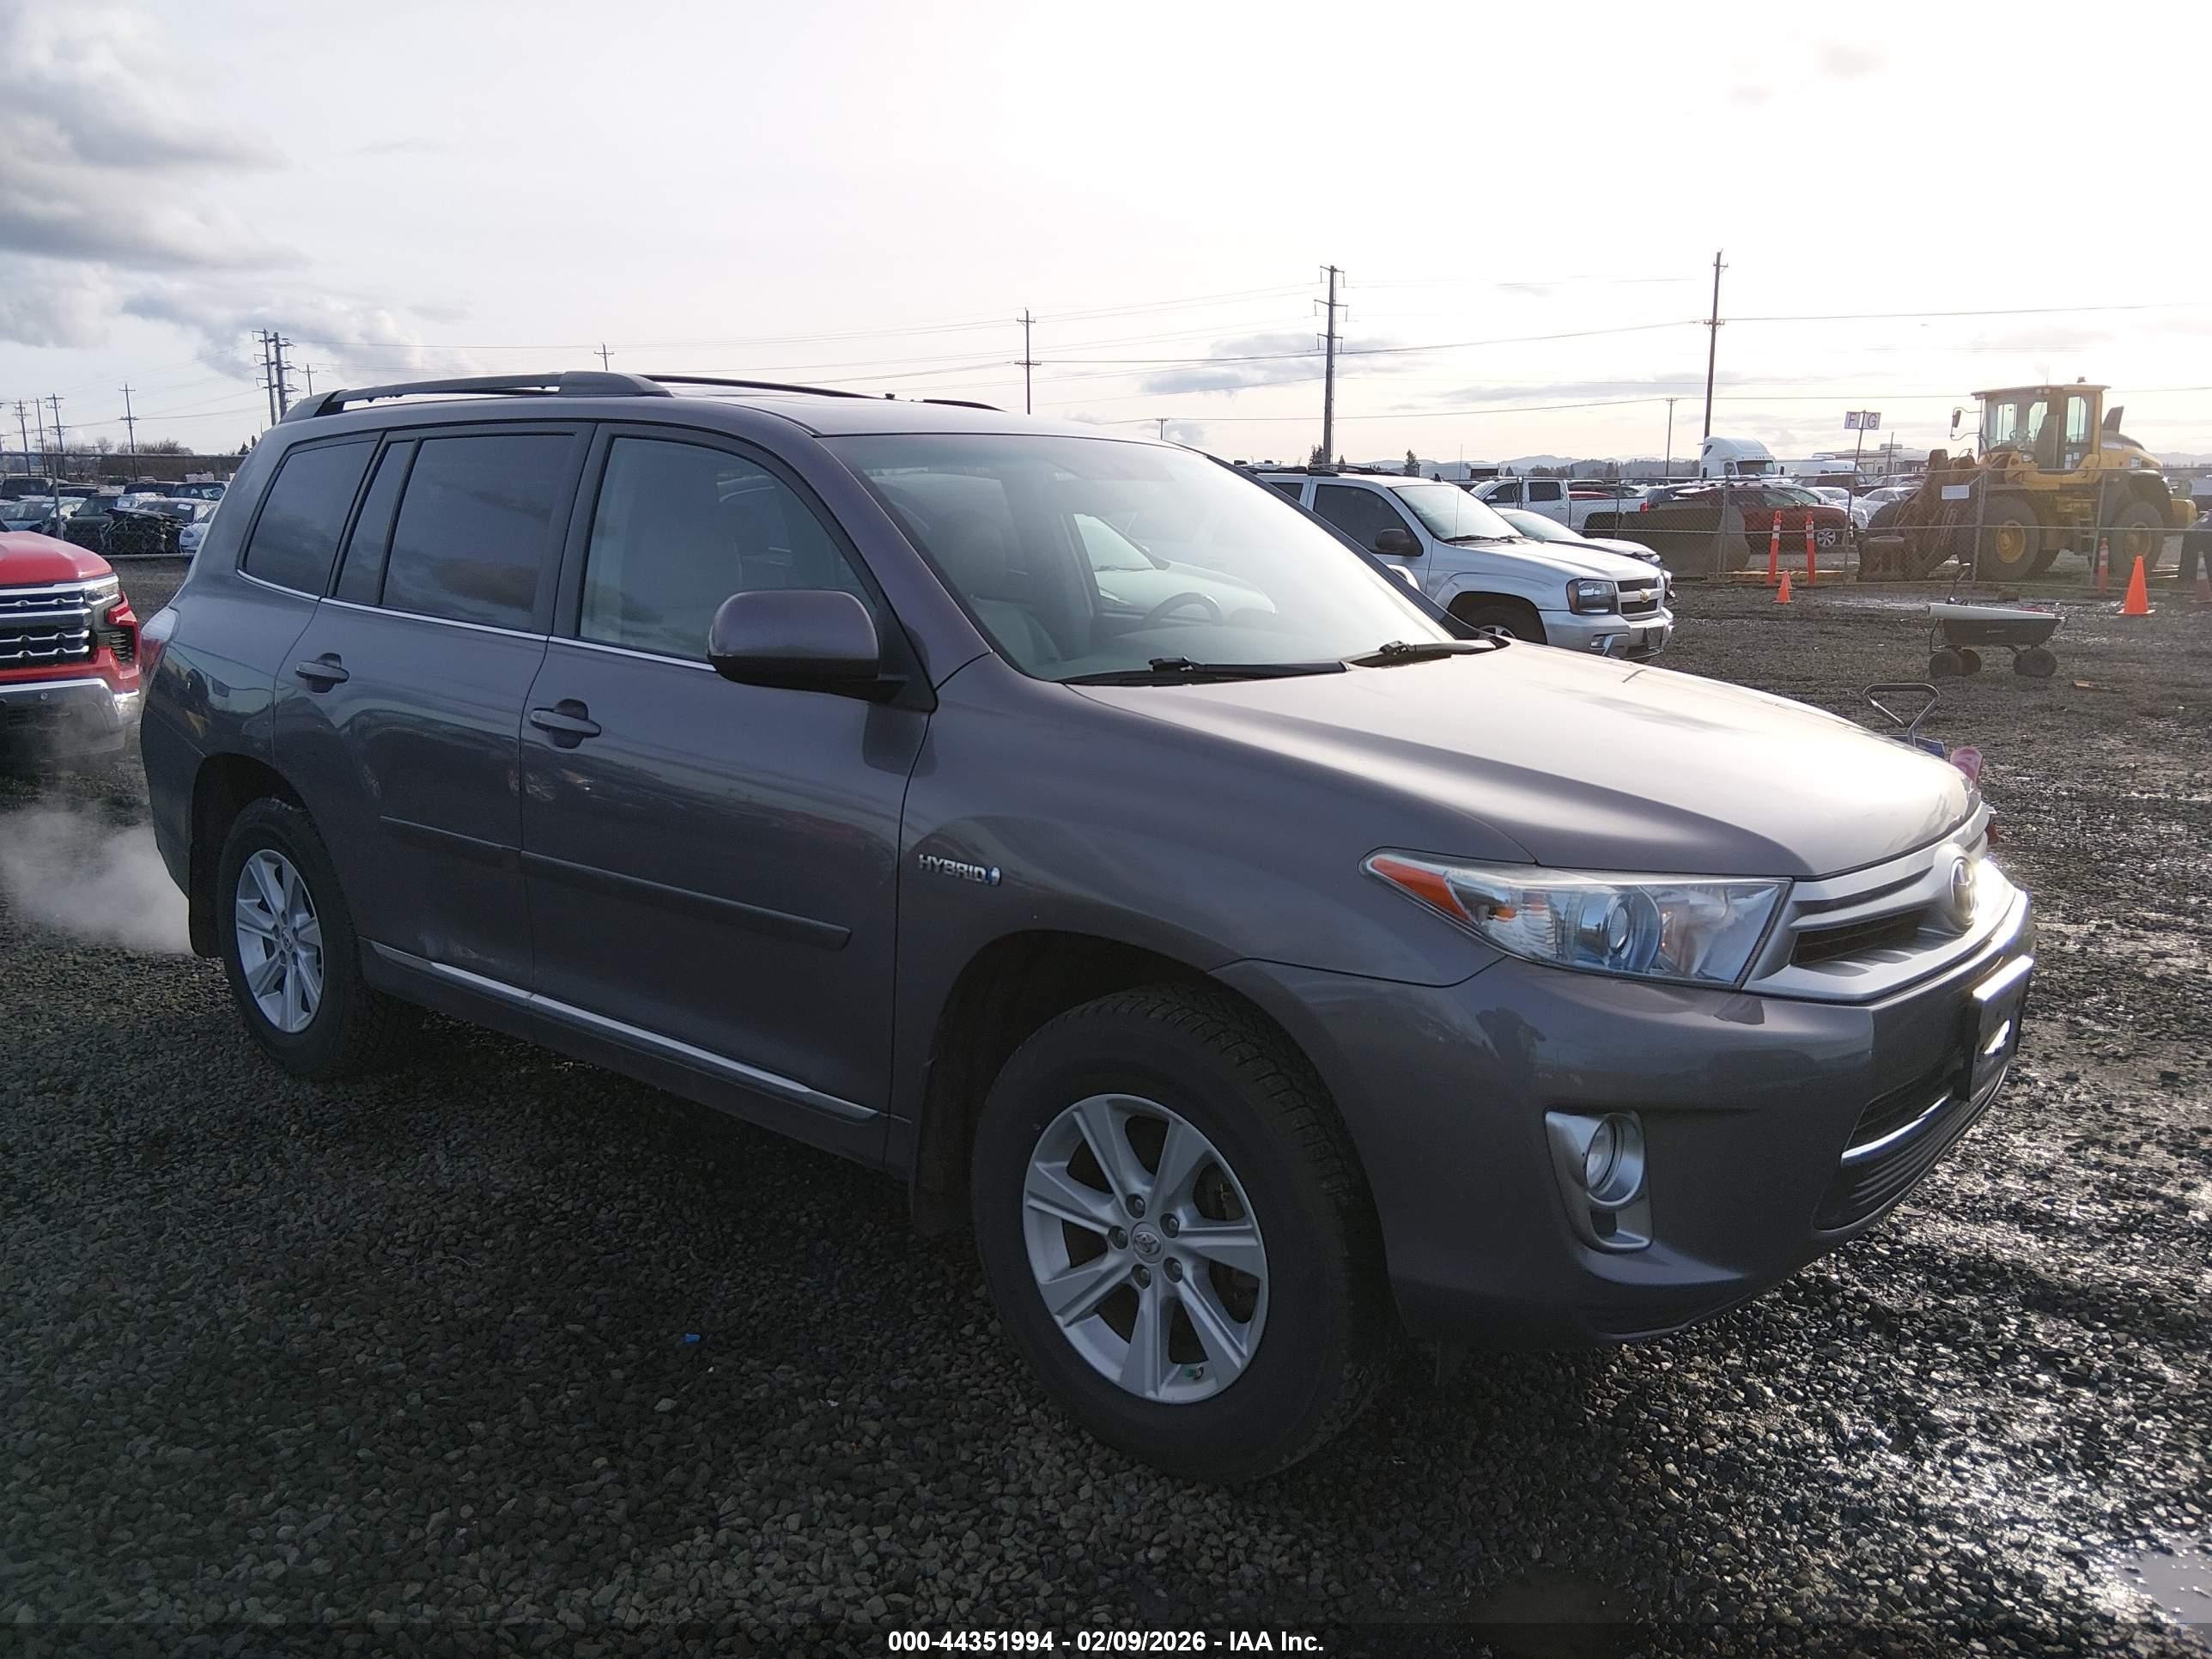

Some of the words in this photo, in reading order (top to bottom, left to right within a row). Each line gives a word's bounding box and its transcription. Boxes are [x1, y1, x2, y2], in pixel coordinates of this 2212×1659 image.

[1847, 412, 1856, 428] F
[1867, 412, 1877, 428] G
[918, 853, 988, 884] HYBRID
